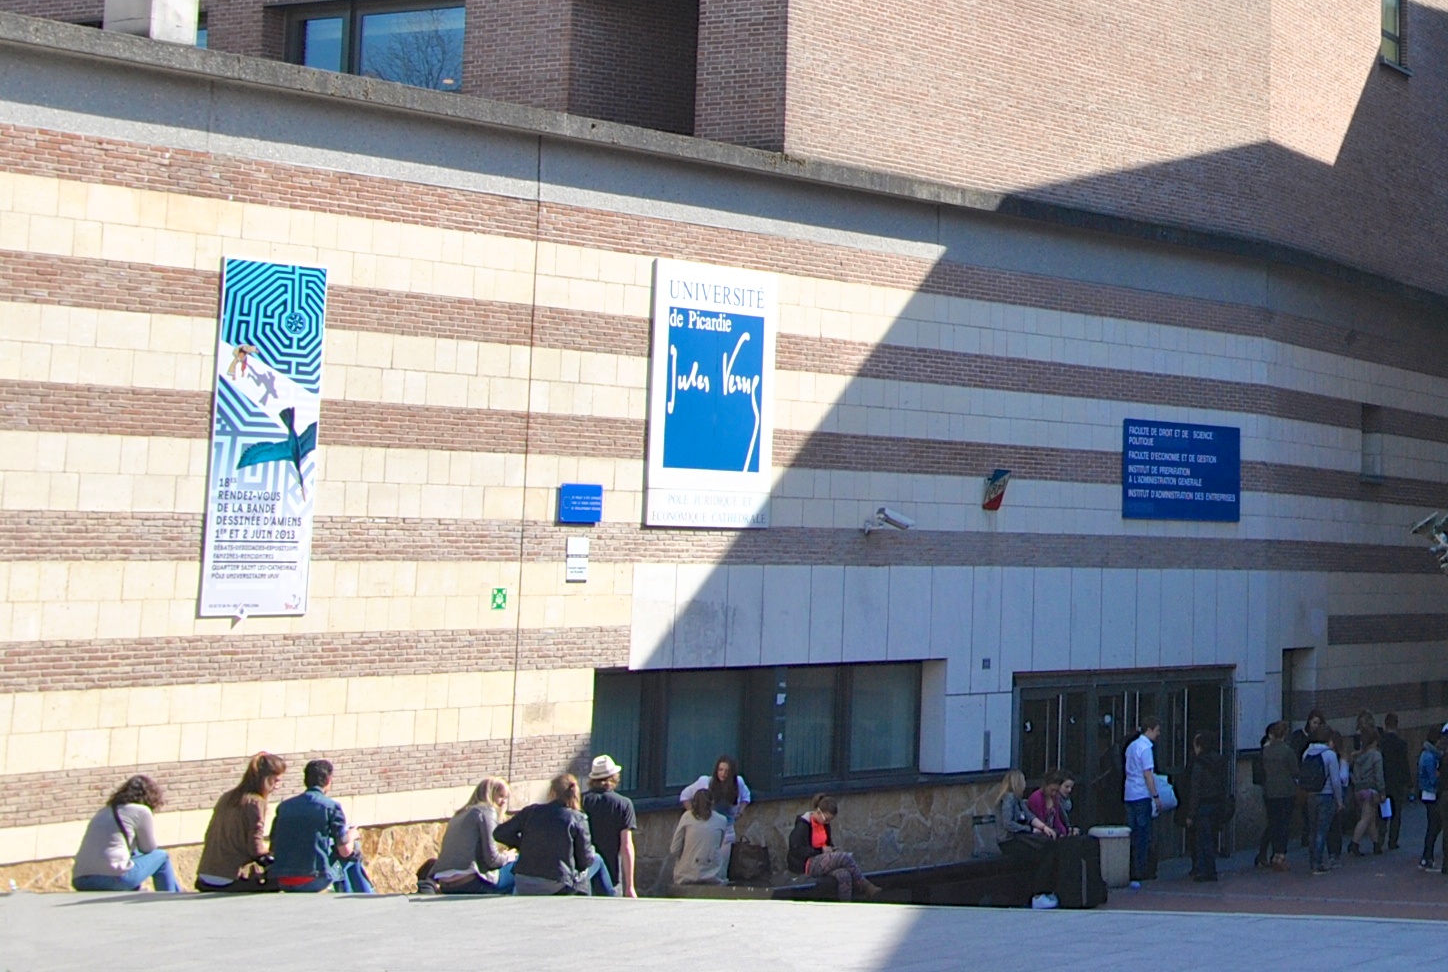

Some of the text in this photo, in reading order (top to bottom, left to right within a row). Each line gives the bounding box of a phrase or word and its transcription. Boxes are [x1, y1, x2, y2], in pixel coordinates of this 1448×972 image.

[670, 280, 764, 309] UNIVERSITÉ
[669, 308, 732, 332] de Picardie
[667, 332, 760, 471] Jules Verne
[1129, 426, 1213, 440] FACULTE DE DROIT ET DE SCIENCE
[1128, 437, 1154, 446] POLITIQUE
[1128, 450, 1149, 460] FACULTE
[1181, 454, 1187, 462] ET
[1189, 454, 1195, 462] DE
[1197, 454, 1217, 463] GESTION
[1128, 465, 1191, 476] INSTITUT DE PREPARATION
[1133, 475, 1177, 485] L'ADMINISTRATION
[1178, 478, 1202, 487] GENERALE
[218, 490, 281, 501] RENDEZ-VOUS
[694, 495, 737, 507] JURIDIQUE
[742, 497, 752, 506] ET
[1128, 489, 1236, 502] INSTITUT D'ADMINISTRATION DES ENTREPRISES
[217, 503, 276, 514] DE LA BANDE
[216, 514, 302, 526] DESSINÉE D'AMIENS
[652, 511, 766, 524] ECONOMIQUE CATHEDRALE
[215, 529, 296, 539] 1ER ET 2 JUIN 2013
